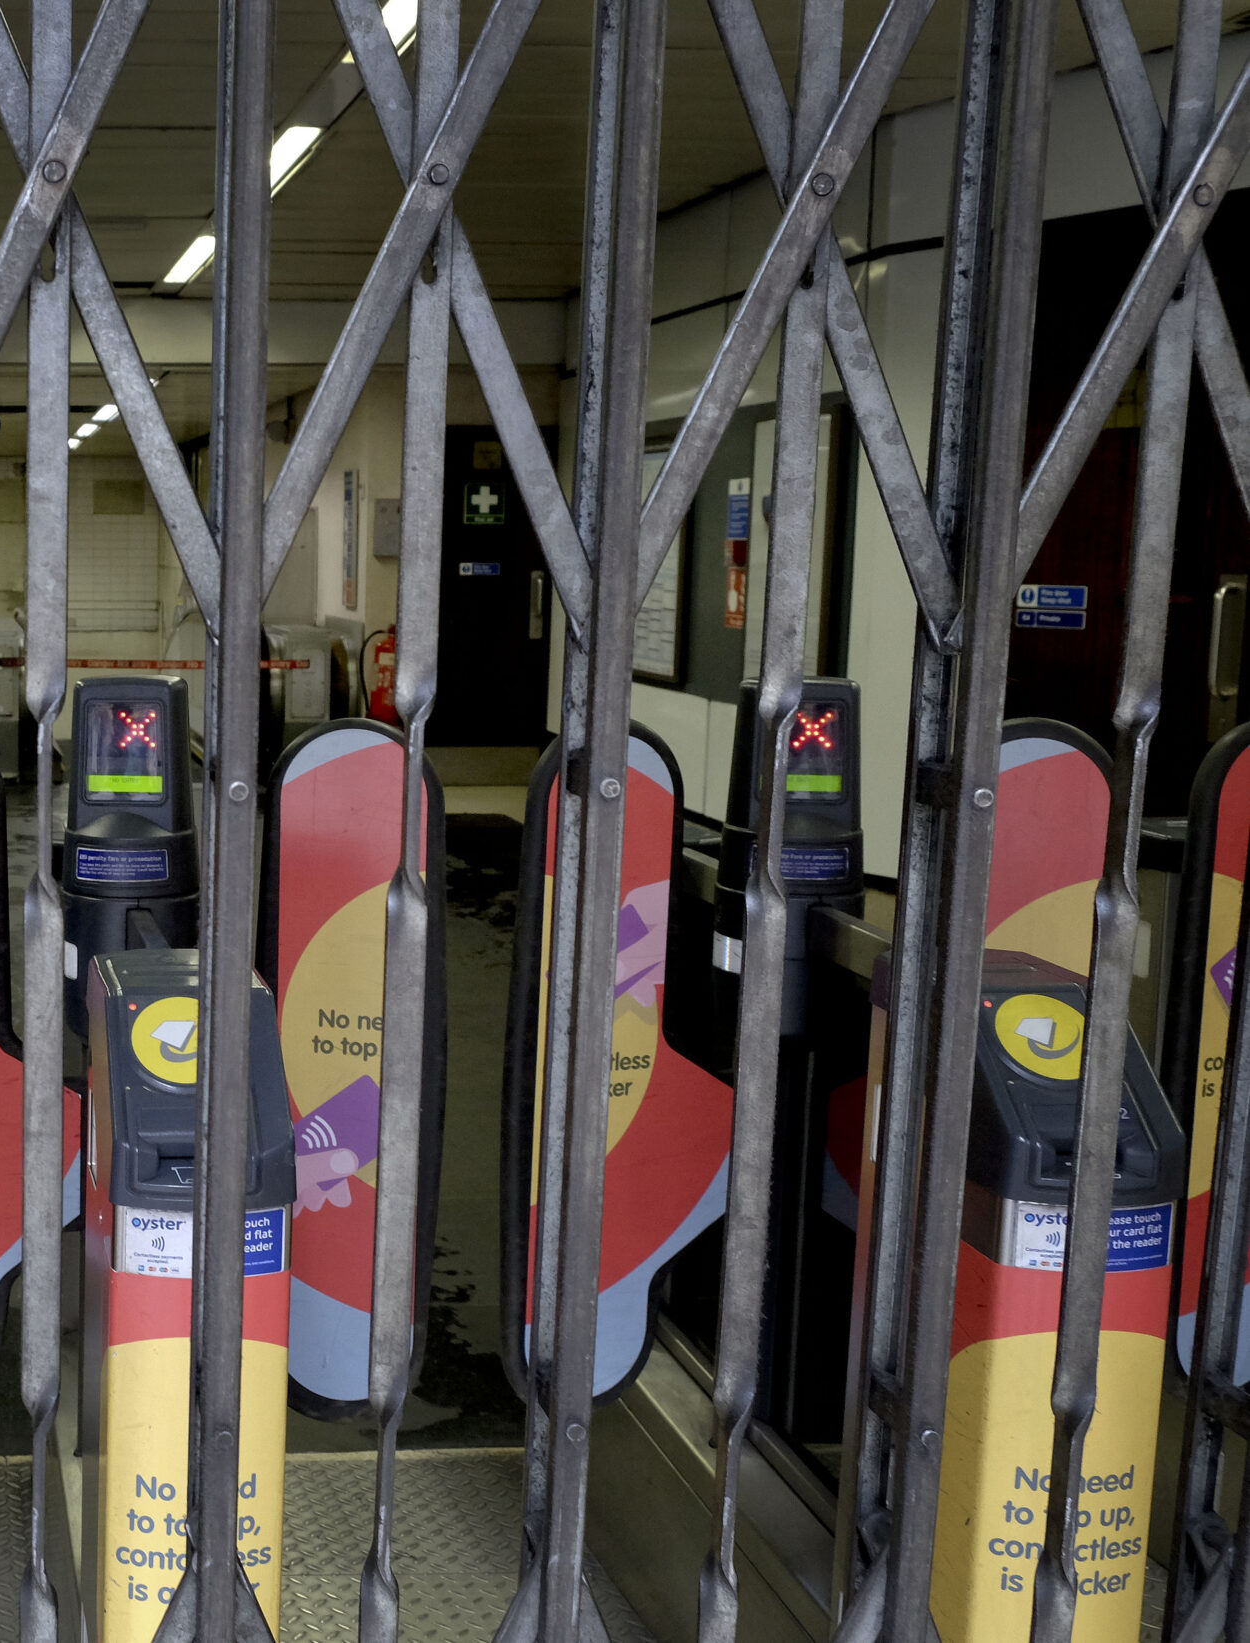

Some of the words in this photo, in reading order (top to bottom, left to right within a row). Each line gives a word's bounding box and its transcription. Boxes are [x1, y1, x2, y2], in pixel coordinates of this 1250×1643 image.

[318, 1008, 350, 1029] No
[357, 1015, 384, 1031] ne
[311, 1035, 334, 1055] to
[340, 1037, 378, 1062] top
[1201, 1078, 1215, 1098] is
[1119, 1107, 1130, 1120] 2
[131, 1217, 183, 1231] oyster
[244, 1216, 270, 1228] ouch
[1024, 1212, 1068, 1227] oyste
[1109, 1215, 1132, 1225] ease
[1134, 1212, 1162, 1224] touch
[254, 1229, 273, 1239] flat
[1123, 1226, 1145, 1237] card
[1147, 1224, 1163, 1234] flat
[244, 1241, 274, 1253] eader
[1112, 1239, 1130, 1250] the
[1133, 1236, 1163, 1248] reader
[136, 1474, 176, 1501] No
[126, 1508, 155, 1534] to
[163, 1513, 187, 1537] to
[1002, 1500, 1034, 1525] to
[1100, 1506, 1135, 1532] up,
[988, 1536, 1142, 1562] conctless
[1000, 1566, 1024, 1592] is
[128, 1575, 149, 1602] is
